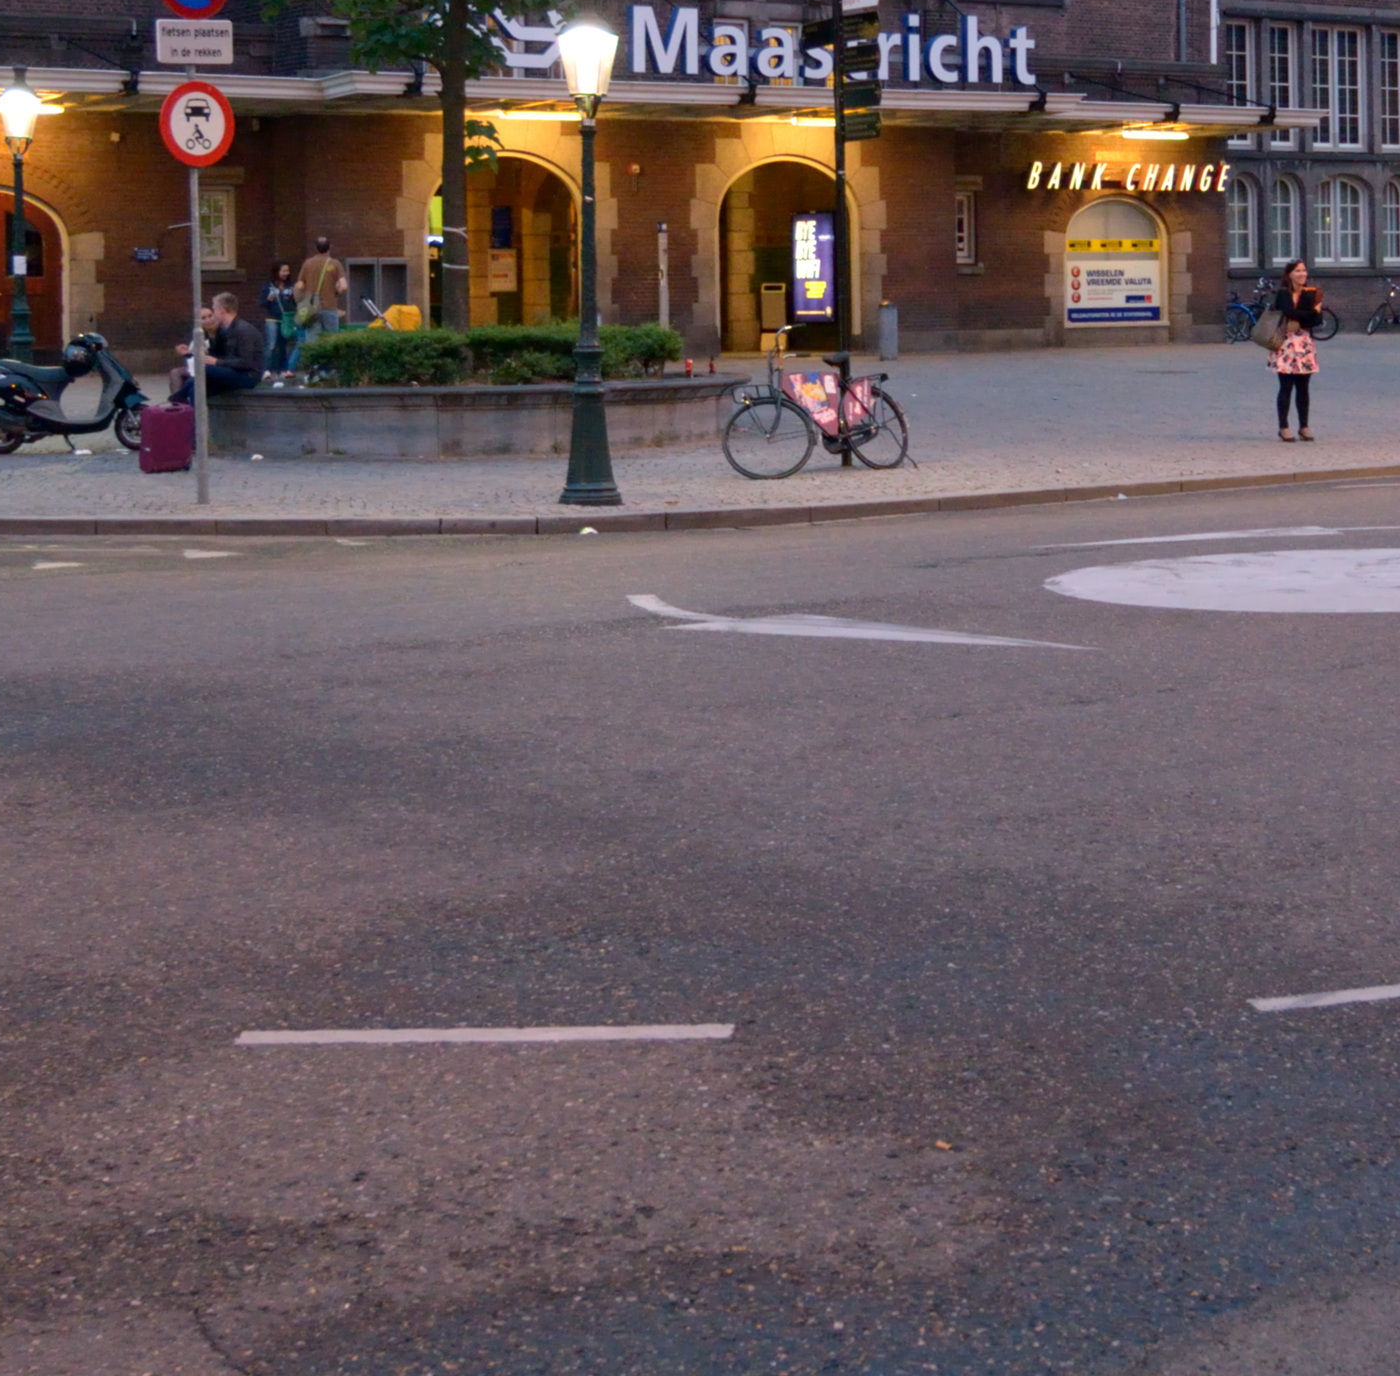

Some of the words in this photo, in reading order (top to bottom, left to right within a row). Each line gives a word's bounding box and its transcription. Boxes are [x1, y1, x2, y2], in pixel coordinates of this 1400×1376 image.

[162, 26, 191, 37] fietsen
[194, 27, 230, 39] plaatsen
[171, 46, 178, 57] in
[181, 47, 191, 57] de
[194, 47, 222, 57] rekken
[1027, 161, 1107, 190] BANK
[1125, 163, 1231, 192] CHANGE
[1086, 269, 1124, 277] WISSELEN
[1086, 278, 1122, 286] VREEMDE
[1124, 277, 1152, 286] VALUTA
